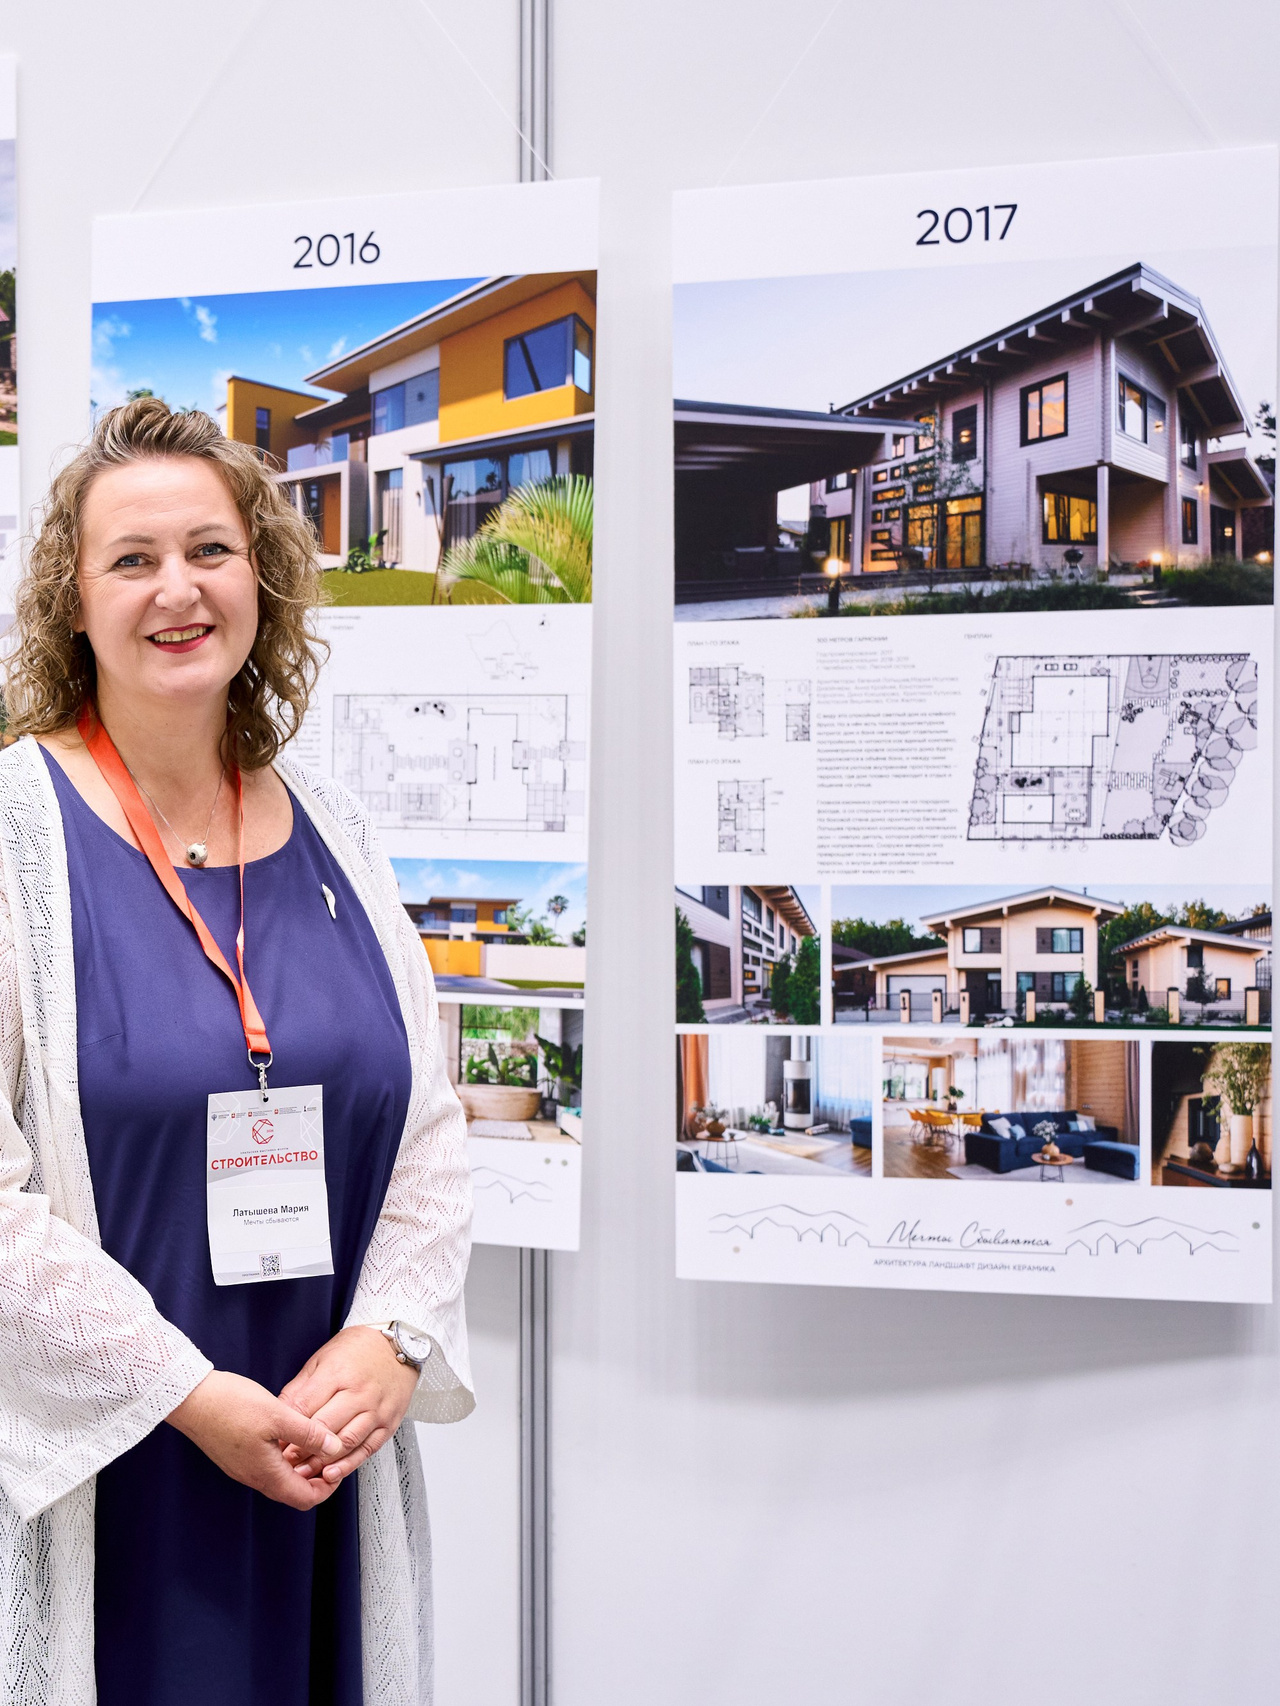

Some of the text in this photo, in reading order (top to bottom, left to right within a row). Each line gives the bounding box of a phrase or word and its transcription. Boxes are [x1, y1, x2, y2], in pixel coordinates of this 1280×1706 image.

[916, 204, 1017, 245] 2017
[294, 232, 380, 268] 2016
[211, 1150, 318, 1170] СТРОИТЕЛЬСТВО
[232, 1205, 309, 1217] Латышева Мария
[243, 1216, 299, 1226] Мечты сбываются
[887, 1219, 1052, 1249] Мечты Сбываются
[873, 1258, 1055, 1272] АРХИТЕКТУРА ЛАНДШАФТ ДИЗАЙН КЕРАМИКА
